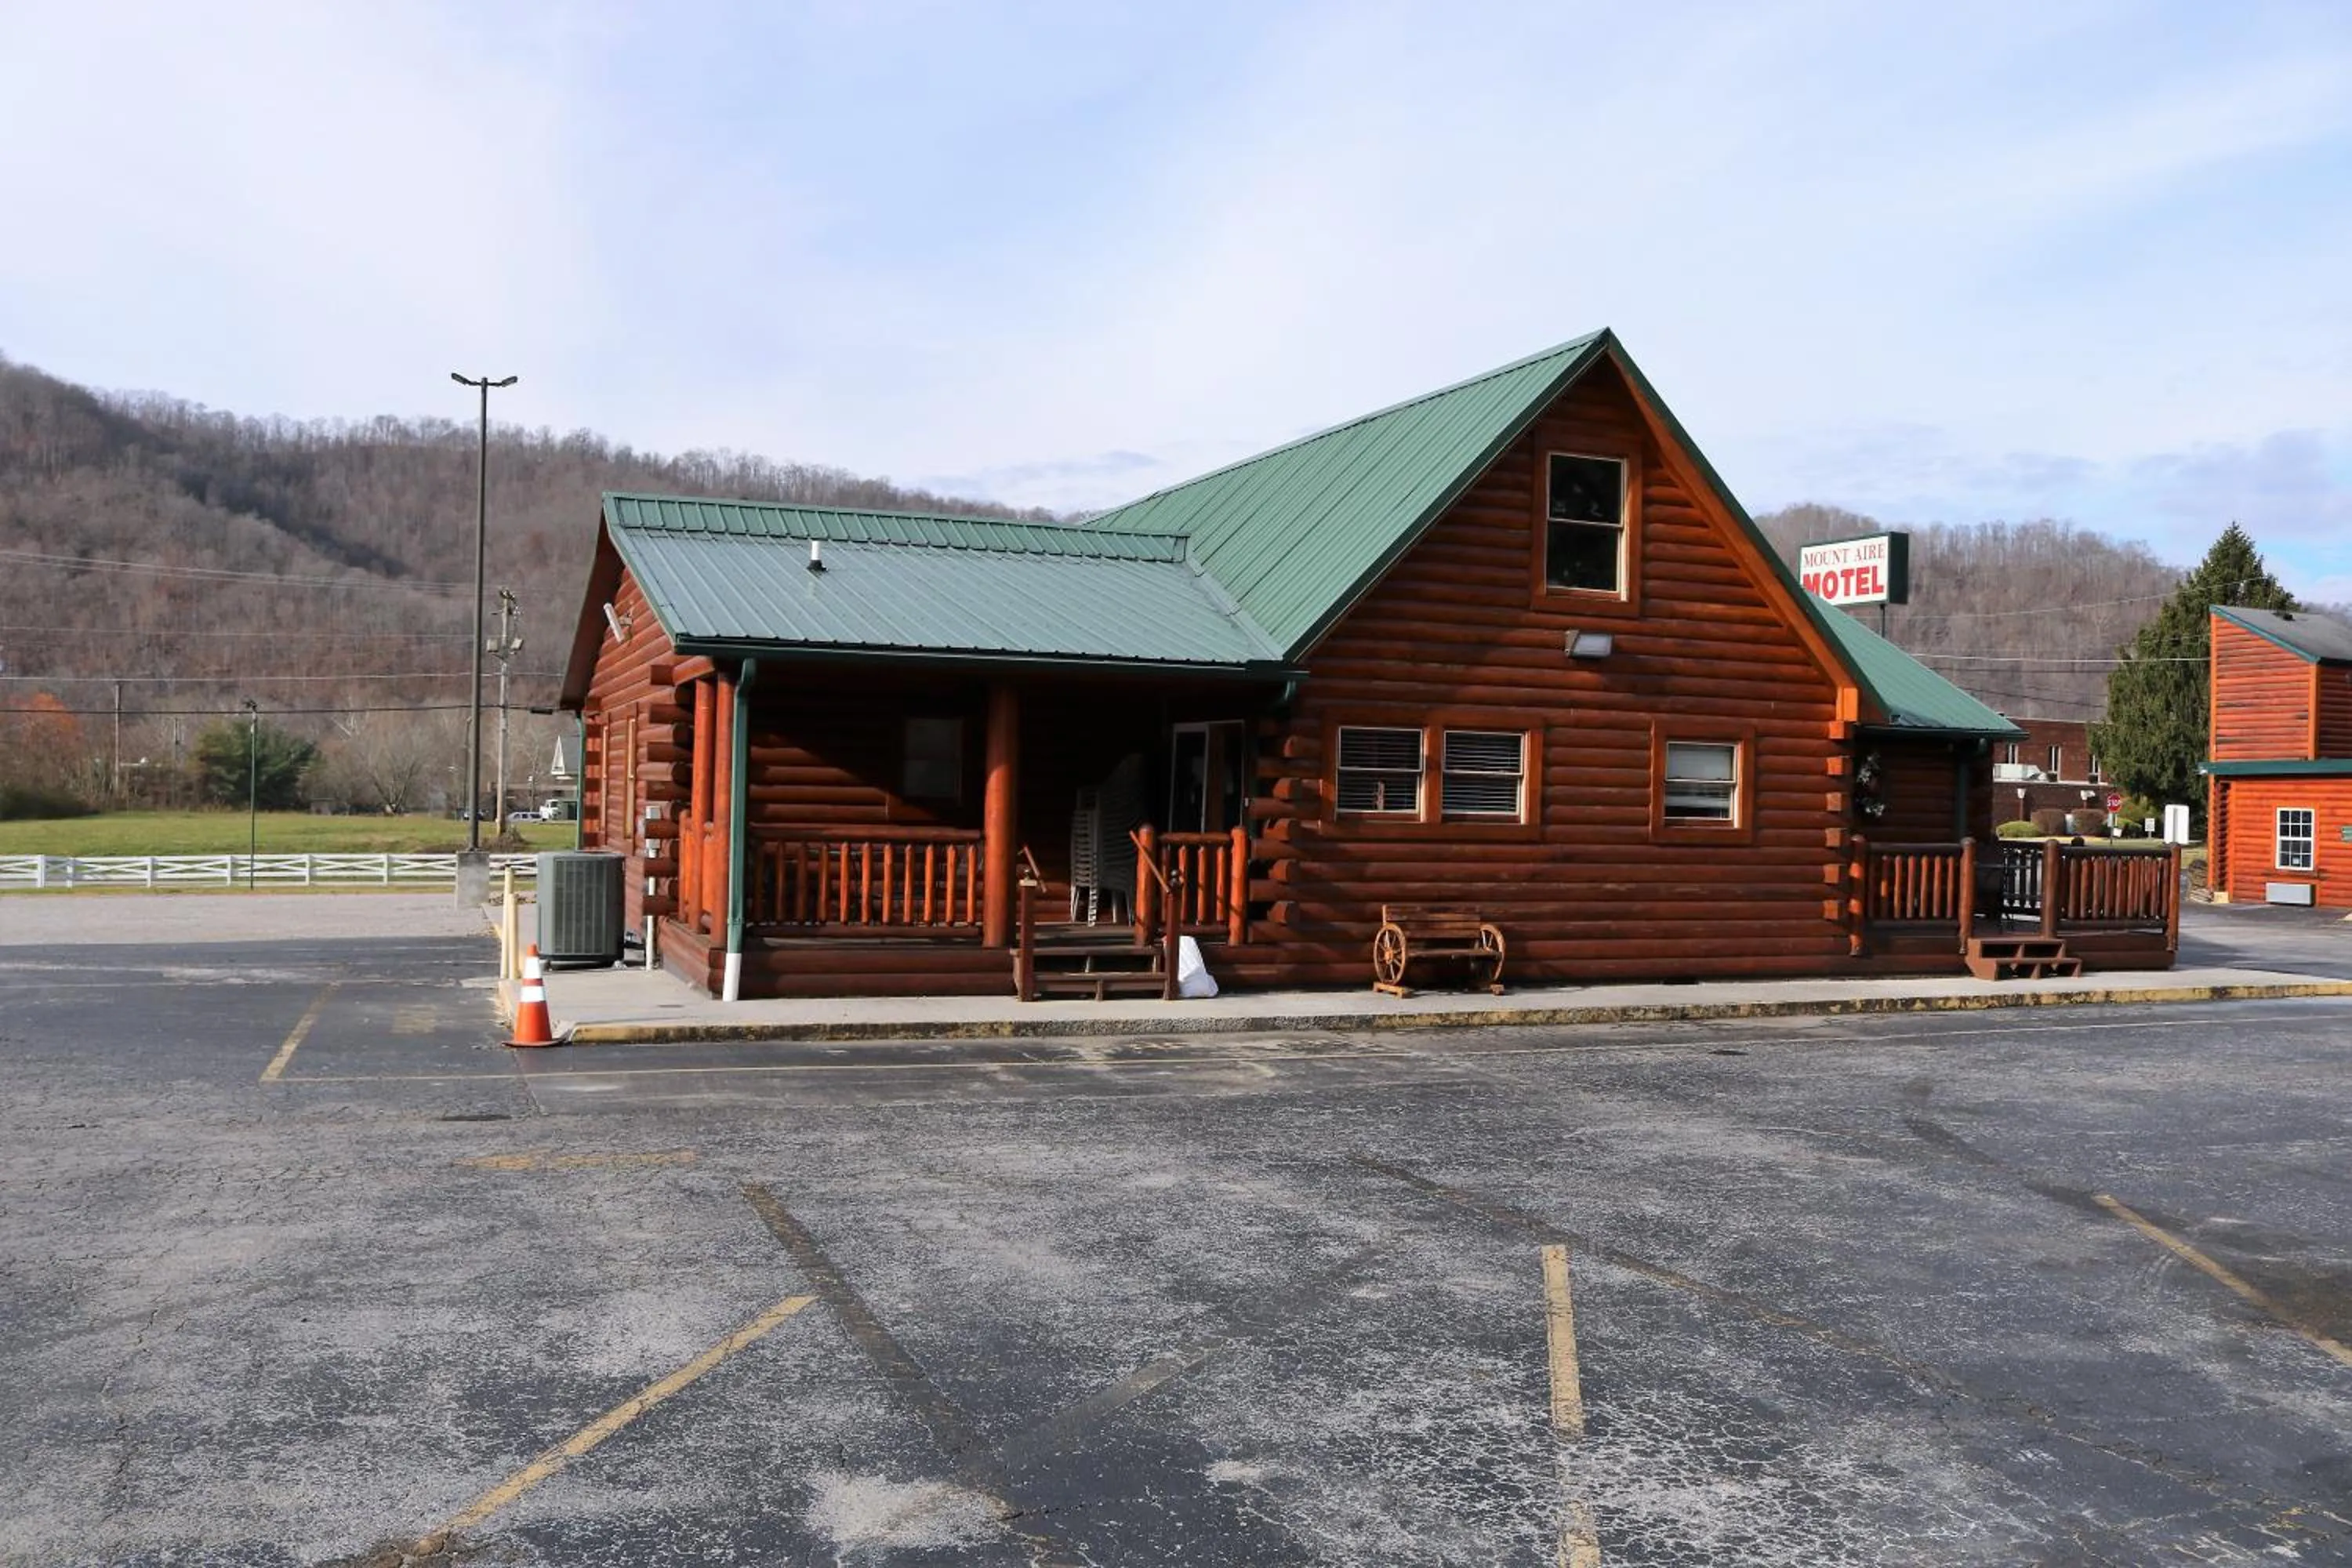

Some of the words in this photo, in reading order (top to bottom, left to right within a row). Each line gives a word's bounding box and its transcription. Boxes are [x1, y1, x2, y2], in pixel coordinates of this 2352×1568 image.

[1803, 548, 1851, 568] MOUNT
[1855, 543, 1886, 563] AIRE
[1802, 565, 1885, 600] MOTEL
[2107, 798, 2121, 807] STOP
